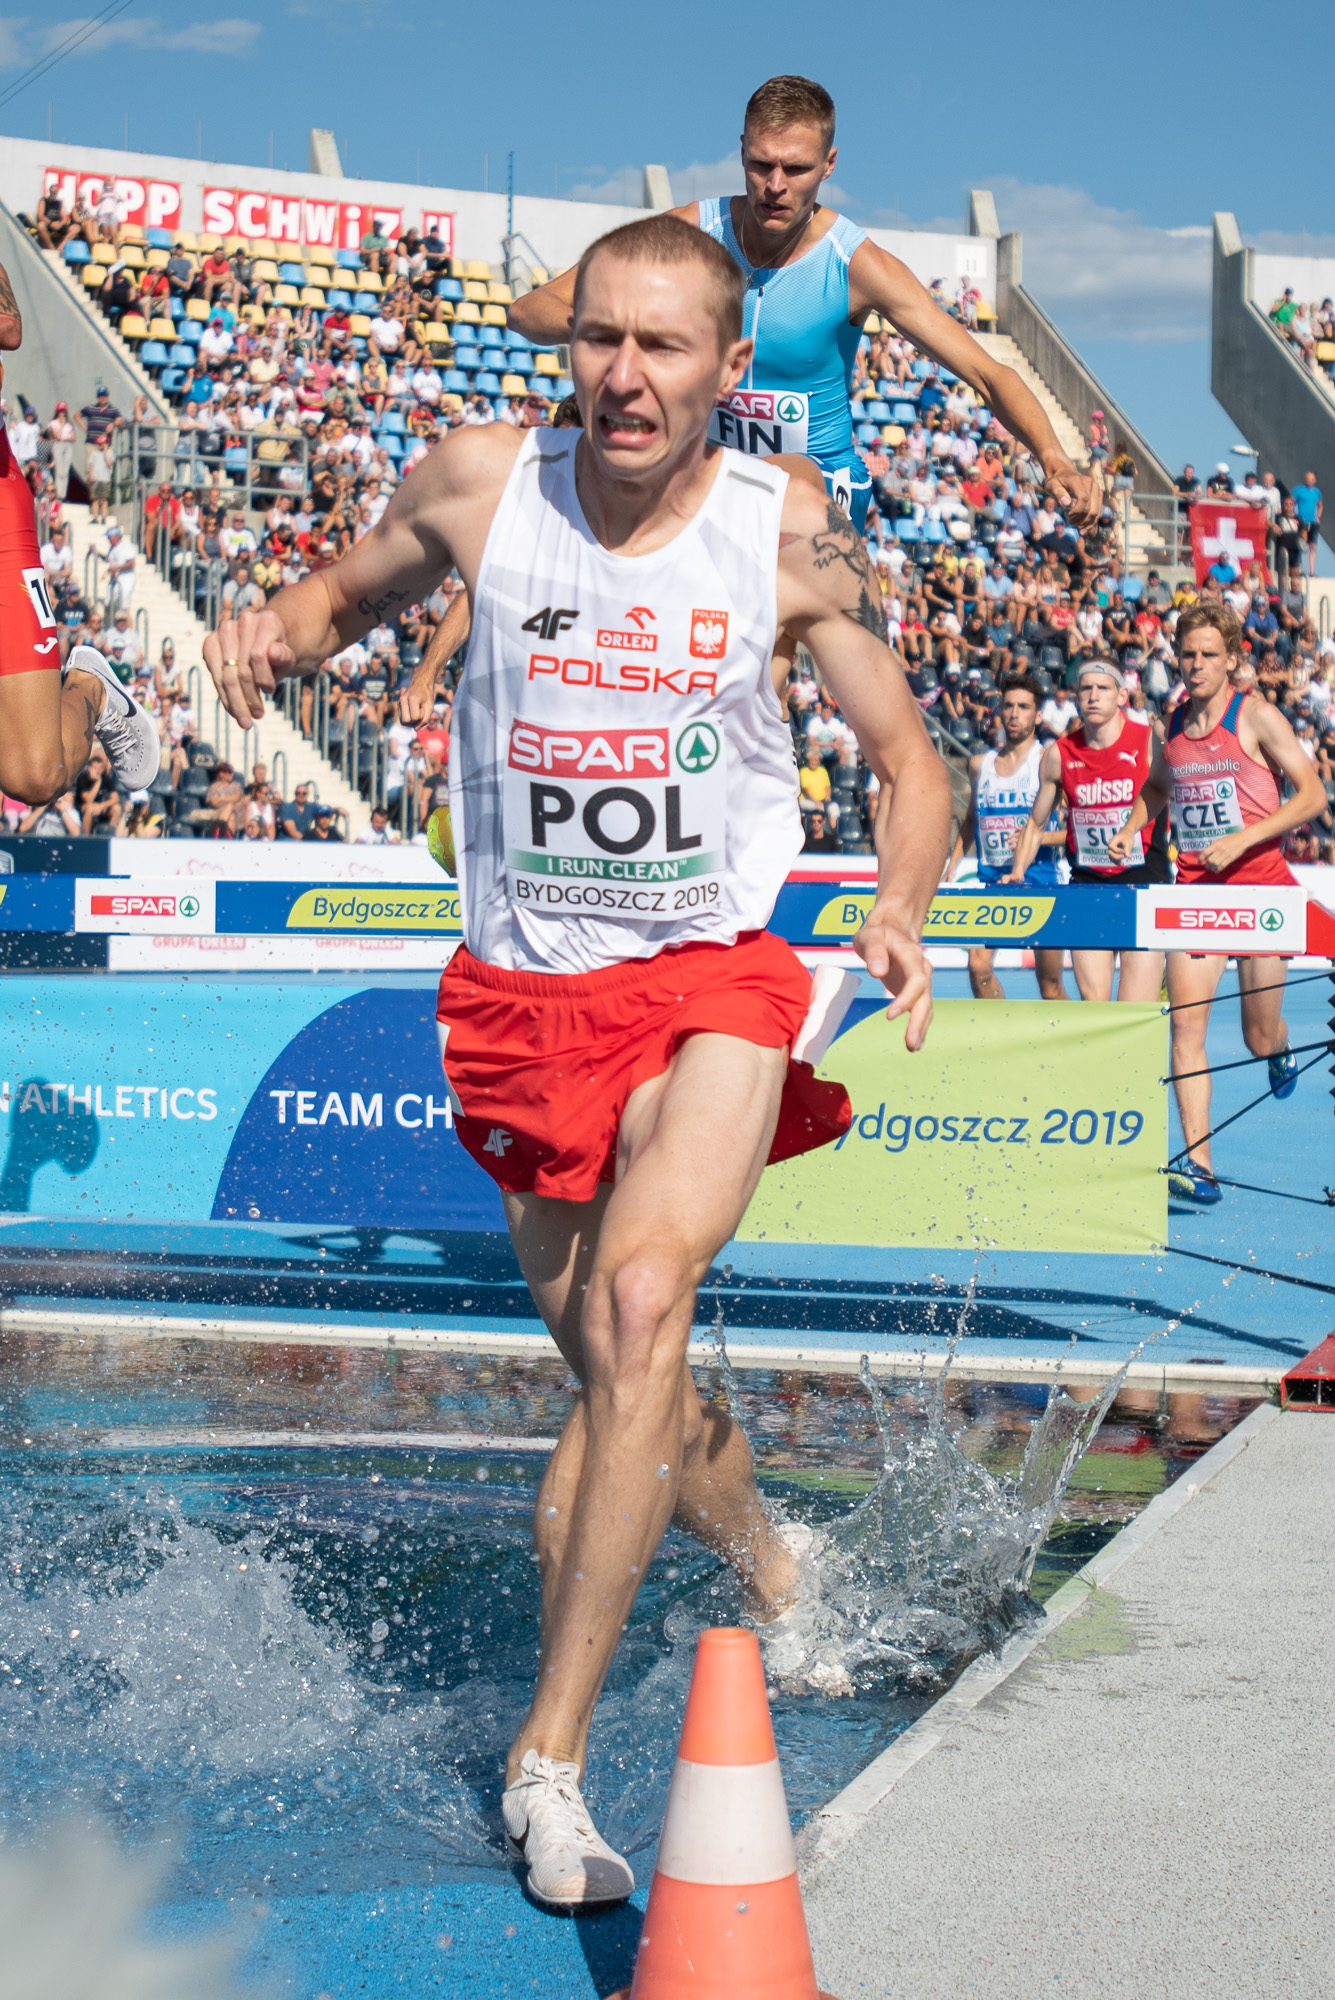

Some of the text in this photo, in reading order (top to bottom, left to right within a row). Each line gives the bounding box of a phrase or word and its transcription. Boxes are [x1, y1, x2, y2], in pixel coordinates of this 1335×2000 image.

[46, 172, 179, 226] HOPP
[717, 410, 783, 454] FIN
[521, 606, 580, 641] 4F
[694, 610, 727, 620] POLSKA
[599, 631, 655, 650] ORLEN
[528, 653, 718, 697] POLSKA
[510, 728, 667, 773] SPAR
[977, 791, 1036, 808] HELLAS
[1176, 785, 1215, 802] SPAR
[530, 781, 703, 855] POL
[980, 818, 1015, 830] SPAR
[1075, 812, 1119, 825] SPAR
[1182, 801, 1231, 829] CZE
[985, 831, 1011, 850] GR
[1087, 827, 1122, 847] SU
[546, 857, 553, 872] I
[559, 859, 604, 876] RUN
[111, 897, 175, 914] SPAR
[516, 879, 720, 912] BYDGOSZCZ 2019
[313, 896, 430, 924] Bydgoszcz
[974, 904, 1033, 926] 2019
[1179, 910, 1255, 928] SPAR
[20, 1082, 218, 1121] ATHLETICS
[269, 1089, 383, 1127] TEAM
[1040, 1108, 1144, 1146] 2019
[482, 1127, 513, 1157] 4F
